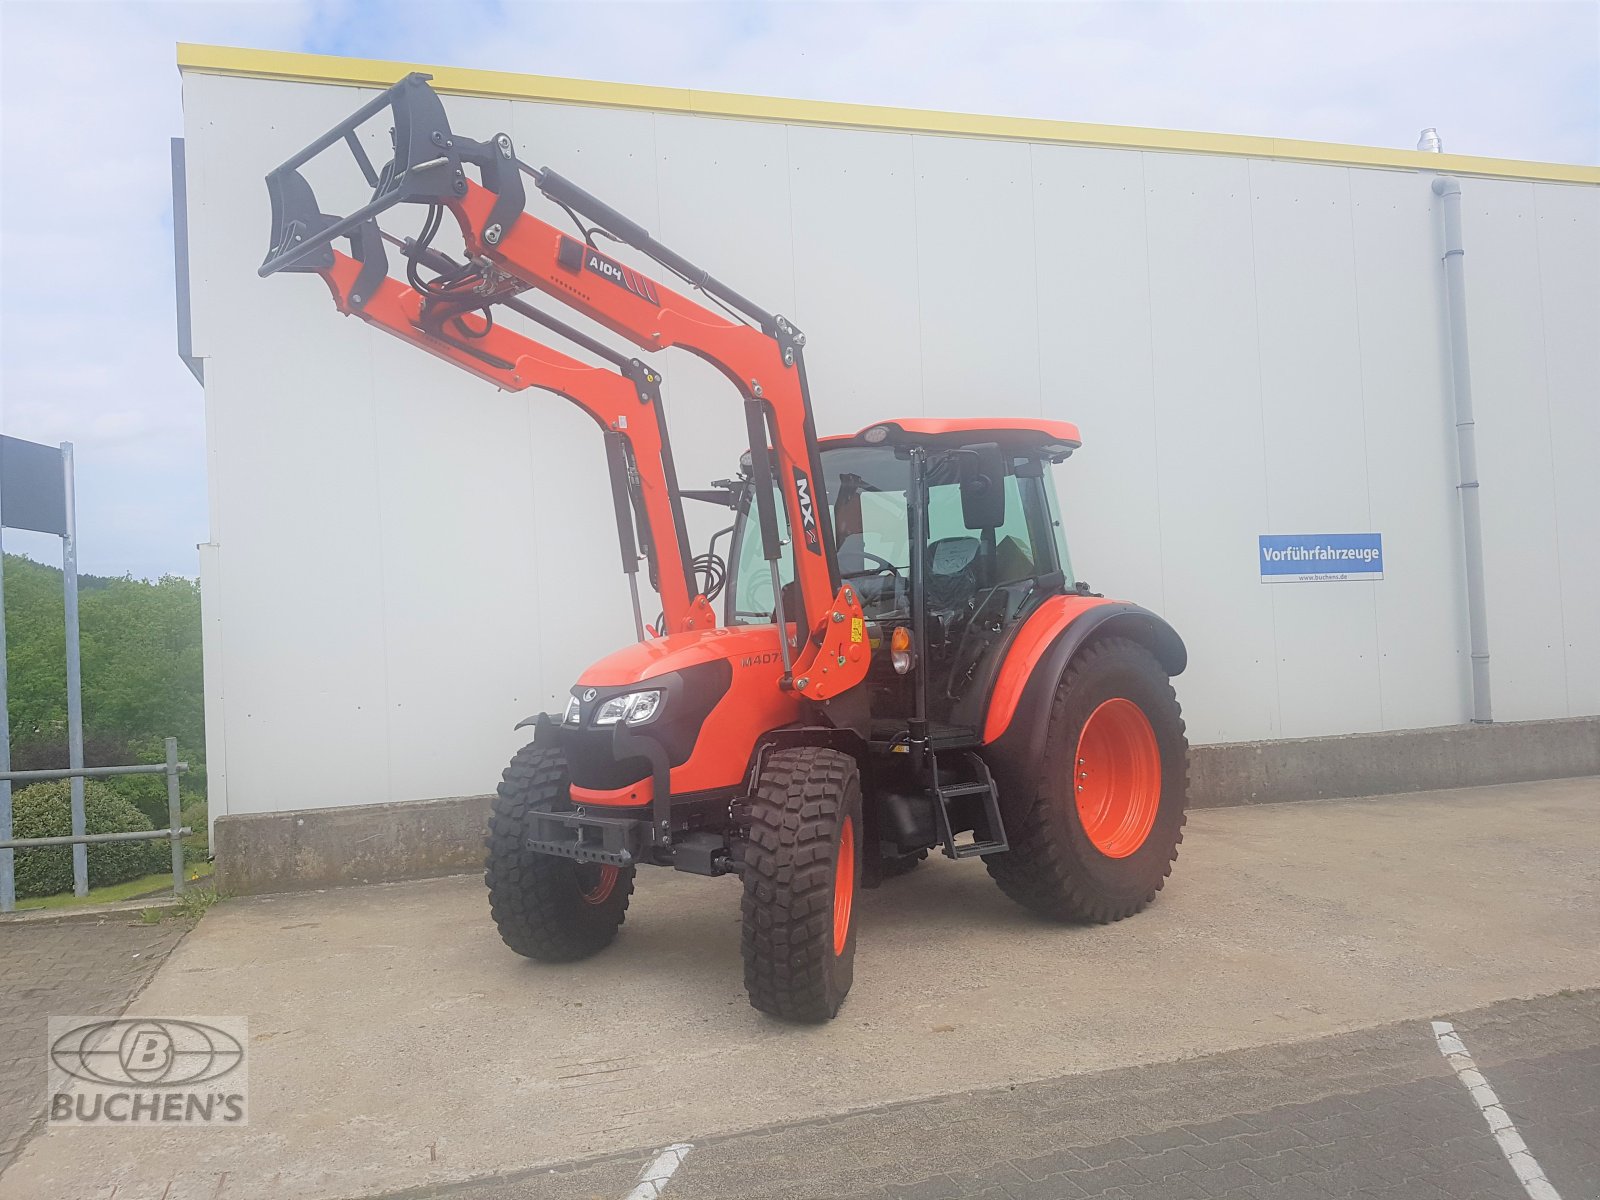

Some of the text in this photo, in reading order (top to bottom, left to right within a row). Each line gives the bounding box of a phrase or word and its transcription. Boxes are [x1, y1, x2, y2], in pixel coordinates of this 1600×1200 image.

[589, 256, 622, 281] A104
[796, 478, 815, 527] MX
[1263, 546, 1379, 562] Vorführfahrzeuge
